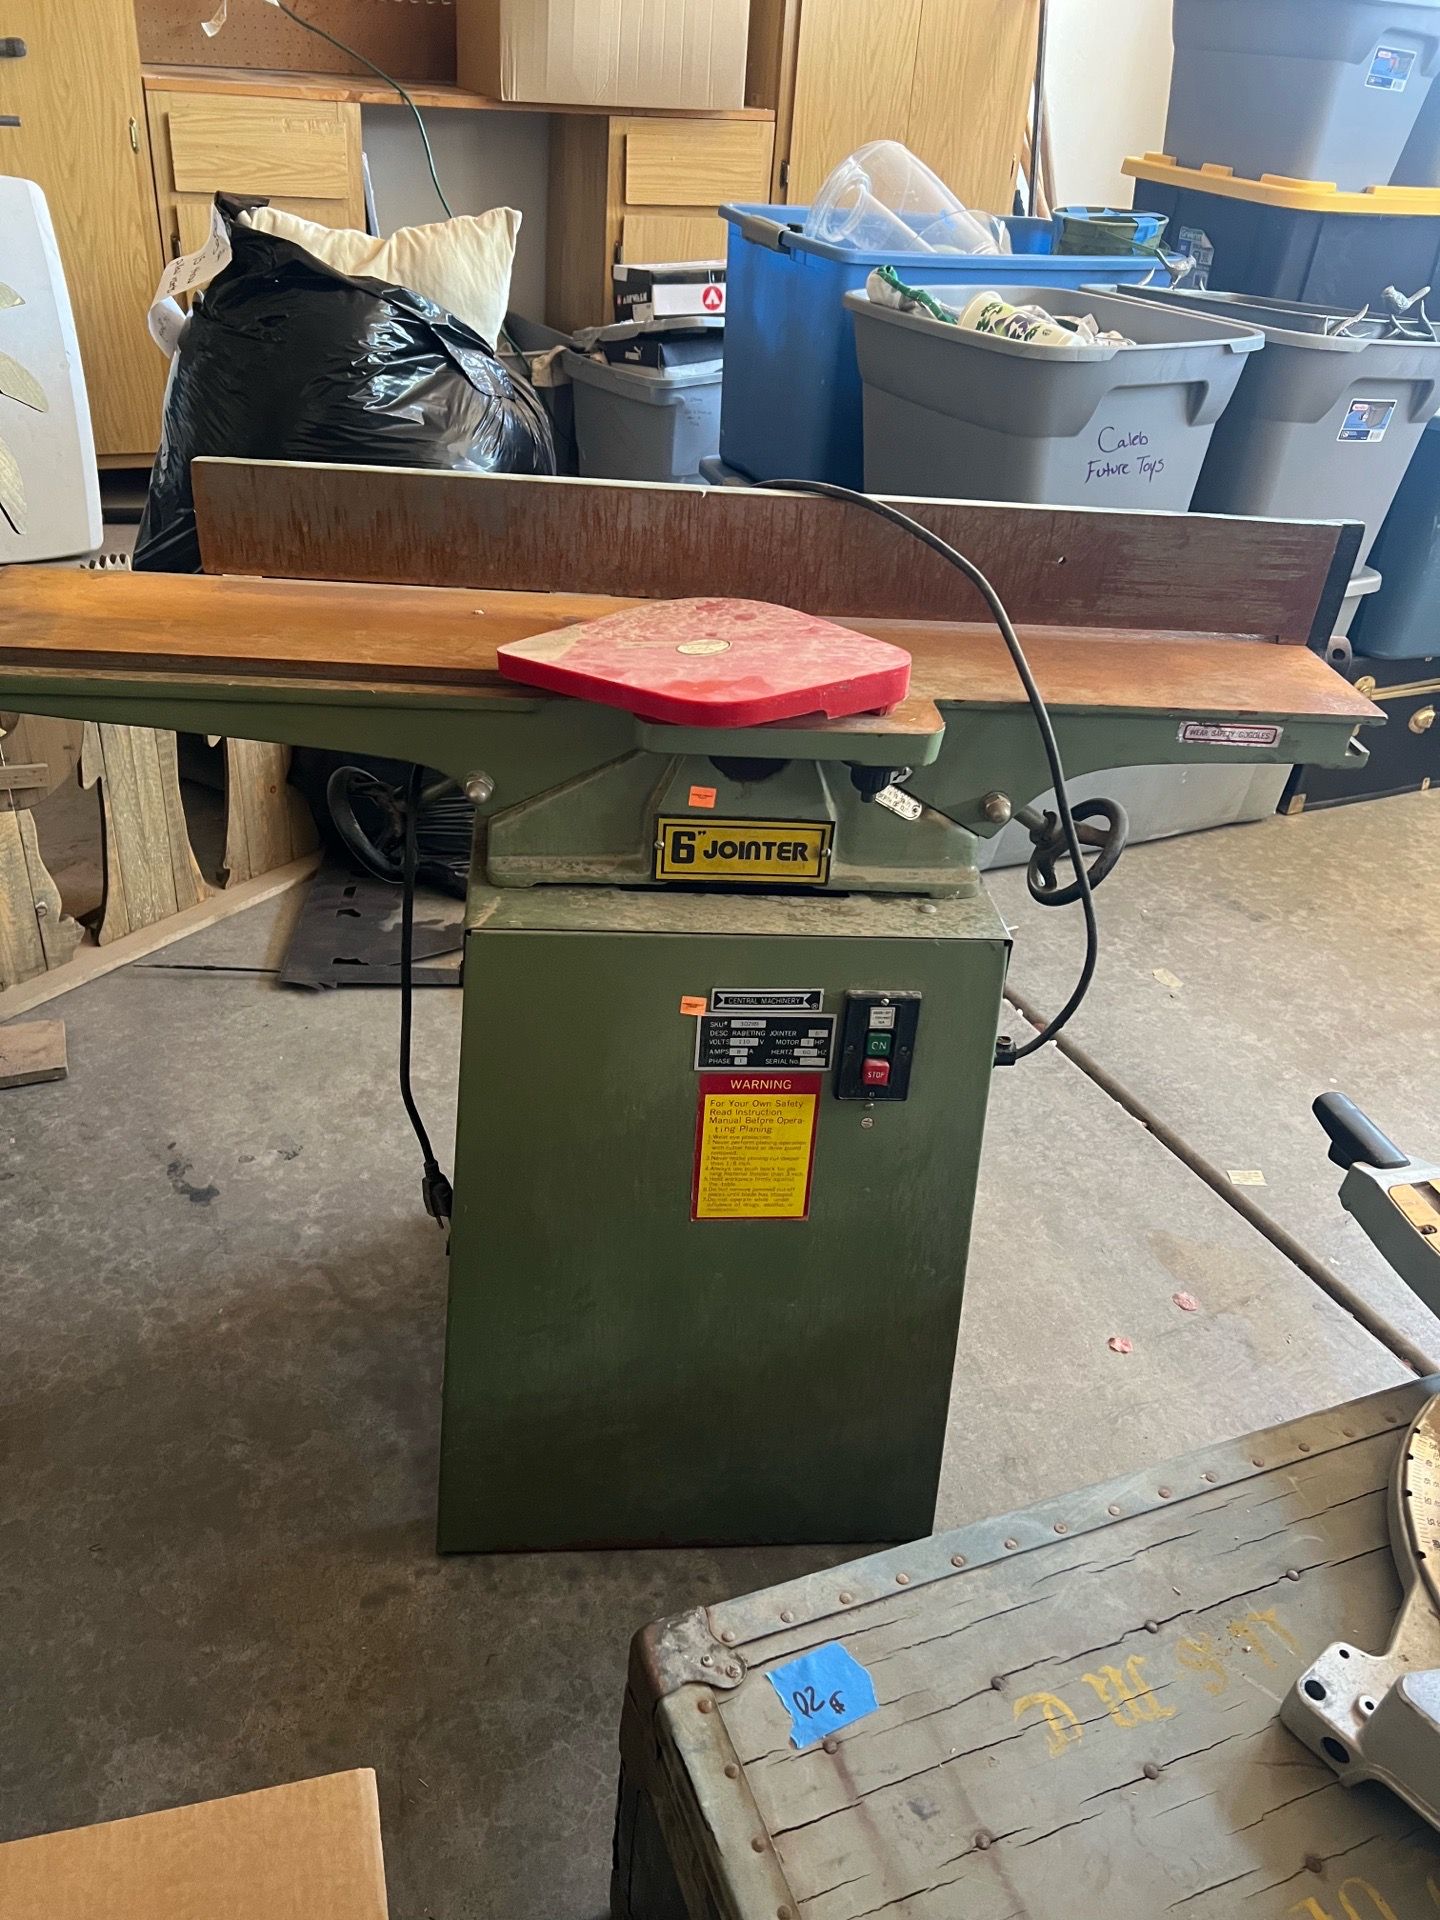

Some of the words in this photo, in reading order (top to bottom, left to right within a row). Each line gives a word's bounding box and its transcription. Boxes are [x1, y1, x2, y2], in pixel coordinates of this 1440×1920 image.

[1097, 426, 1149, 453] Caleb
[1084, 459, 1131, 484] Future
[1136, 454, 1165, 483] Toys
[703, 839, 809, 862] JOINTER
[728, 997, 758, 1005] CENTRAL
[761, 997, 801, 1005] MACHINERY
[871, 1041, 887, 1050] ON
[730, 1079, 792, 1089] WARNING
[775, 1100, 804, 1109] Safety
[709, 1116, 741, 1124] Manual
[745, 1116, 774, 1124] Before
